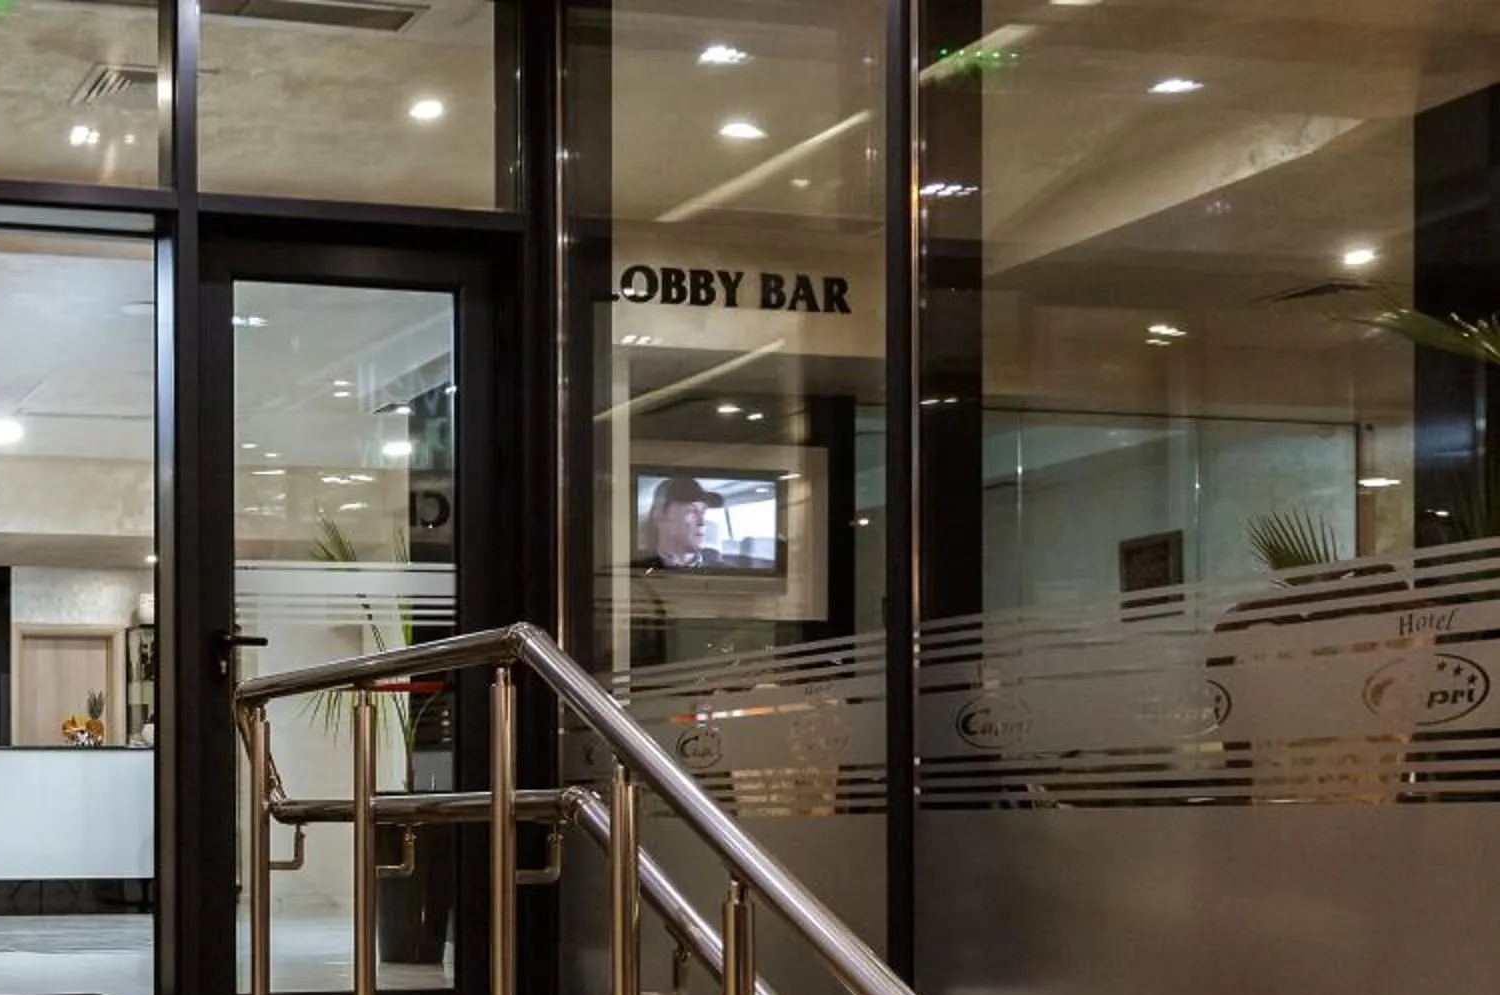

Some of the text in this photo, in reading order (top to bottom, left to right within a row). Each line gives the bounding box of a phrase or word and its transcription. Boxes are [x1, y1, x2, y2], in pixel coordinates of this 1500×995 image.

[610, 265, 852, 314] OBBY BAR
[1398, 607, 1460, 636] Hotel
